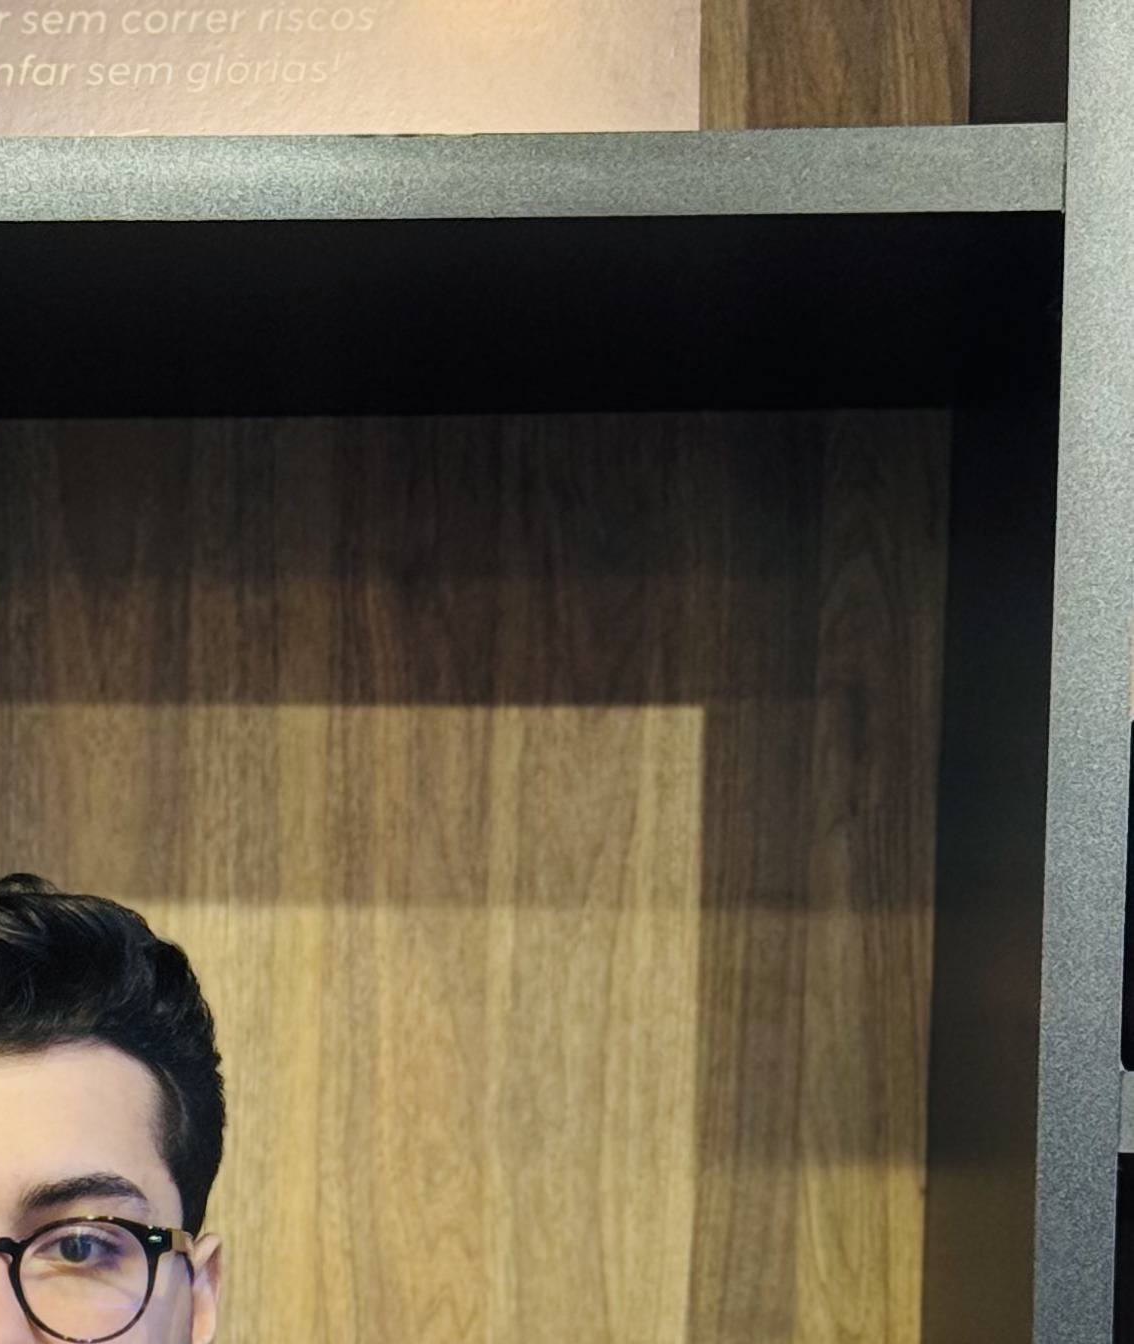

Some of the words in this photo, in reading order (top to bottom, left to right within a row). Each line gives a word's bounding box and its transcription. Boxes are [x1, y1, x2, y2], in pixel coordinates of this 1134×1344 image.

[20, 9, 107, 35] sem
[121, 8, 248, 34] correr
[259, 1, 377, 32] riscos
[85, 61, 173, 87] sem
